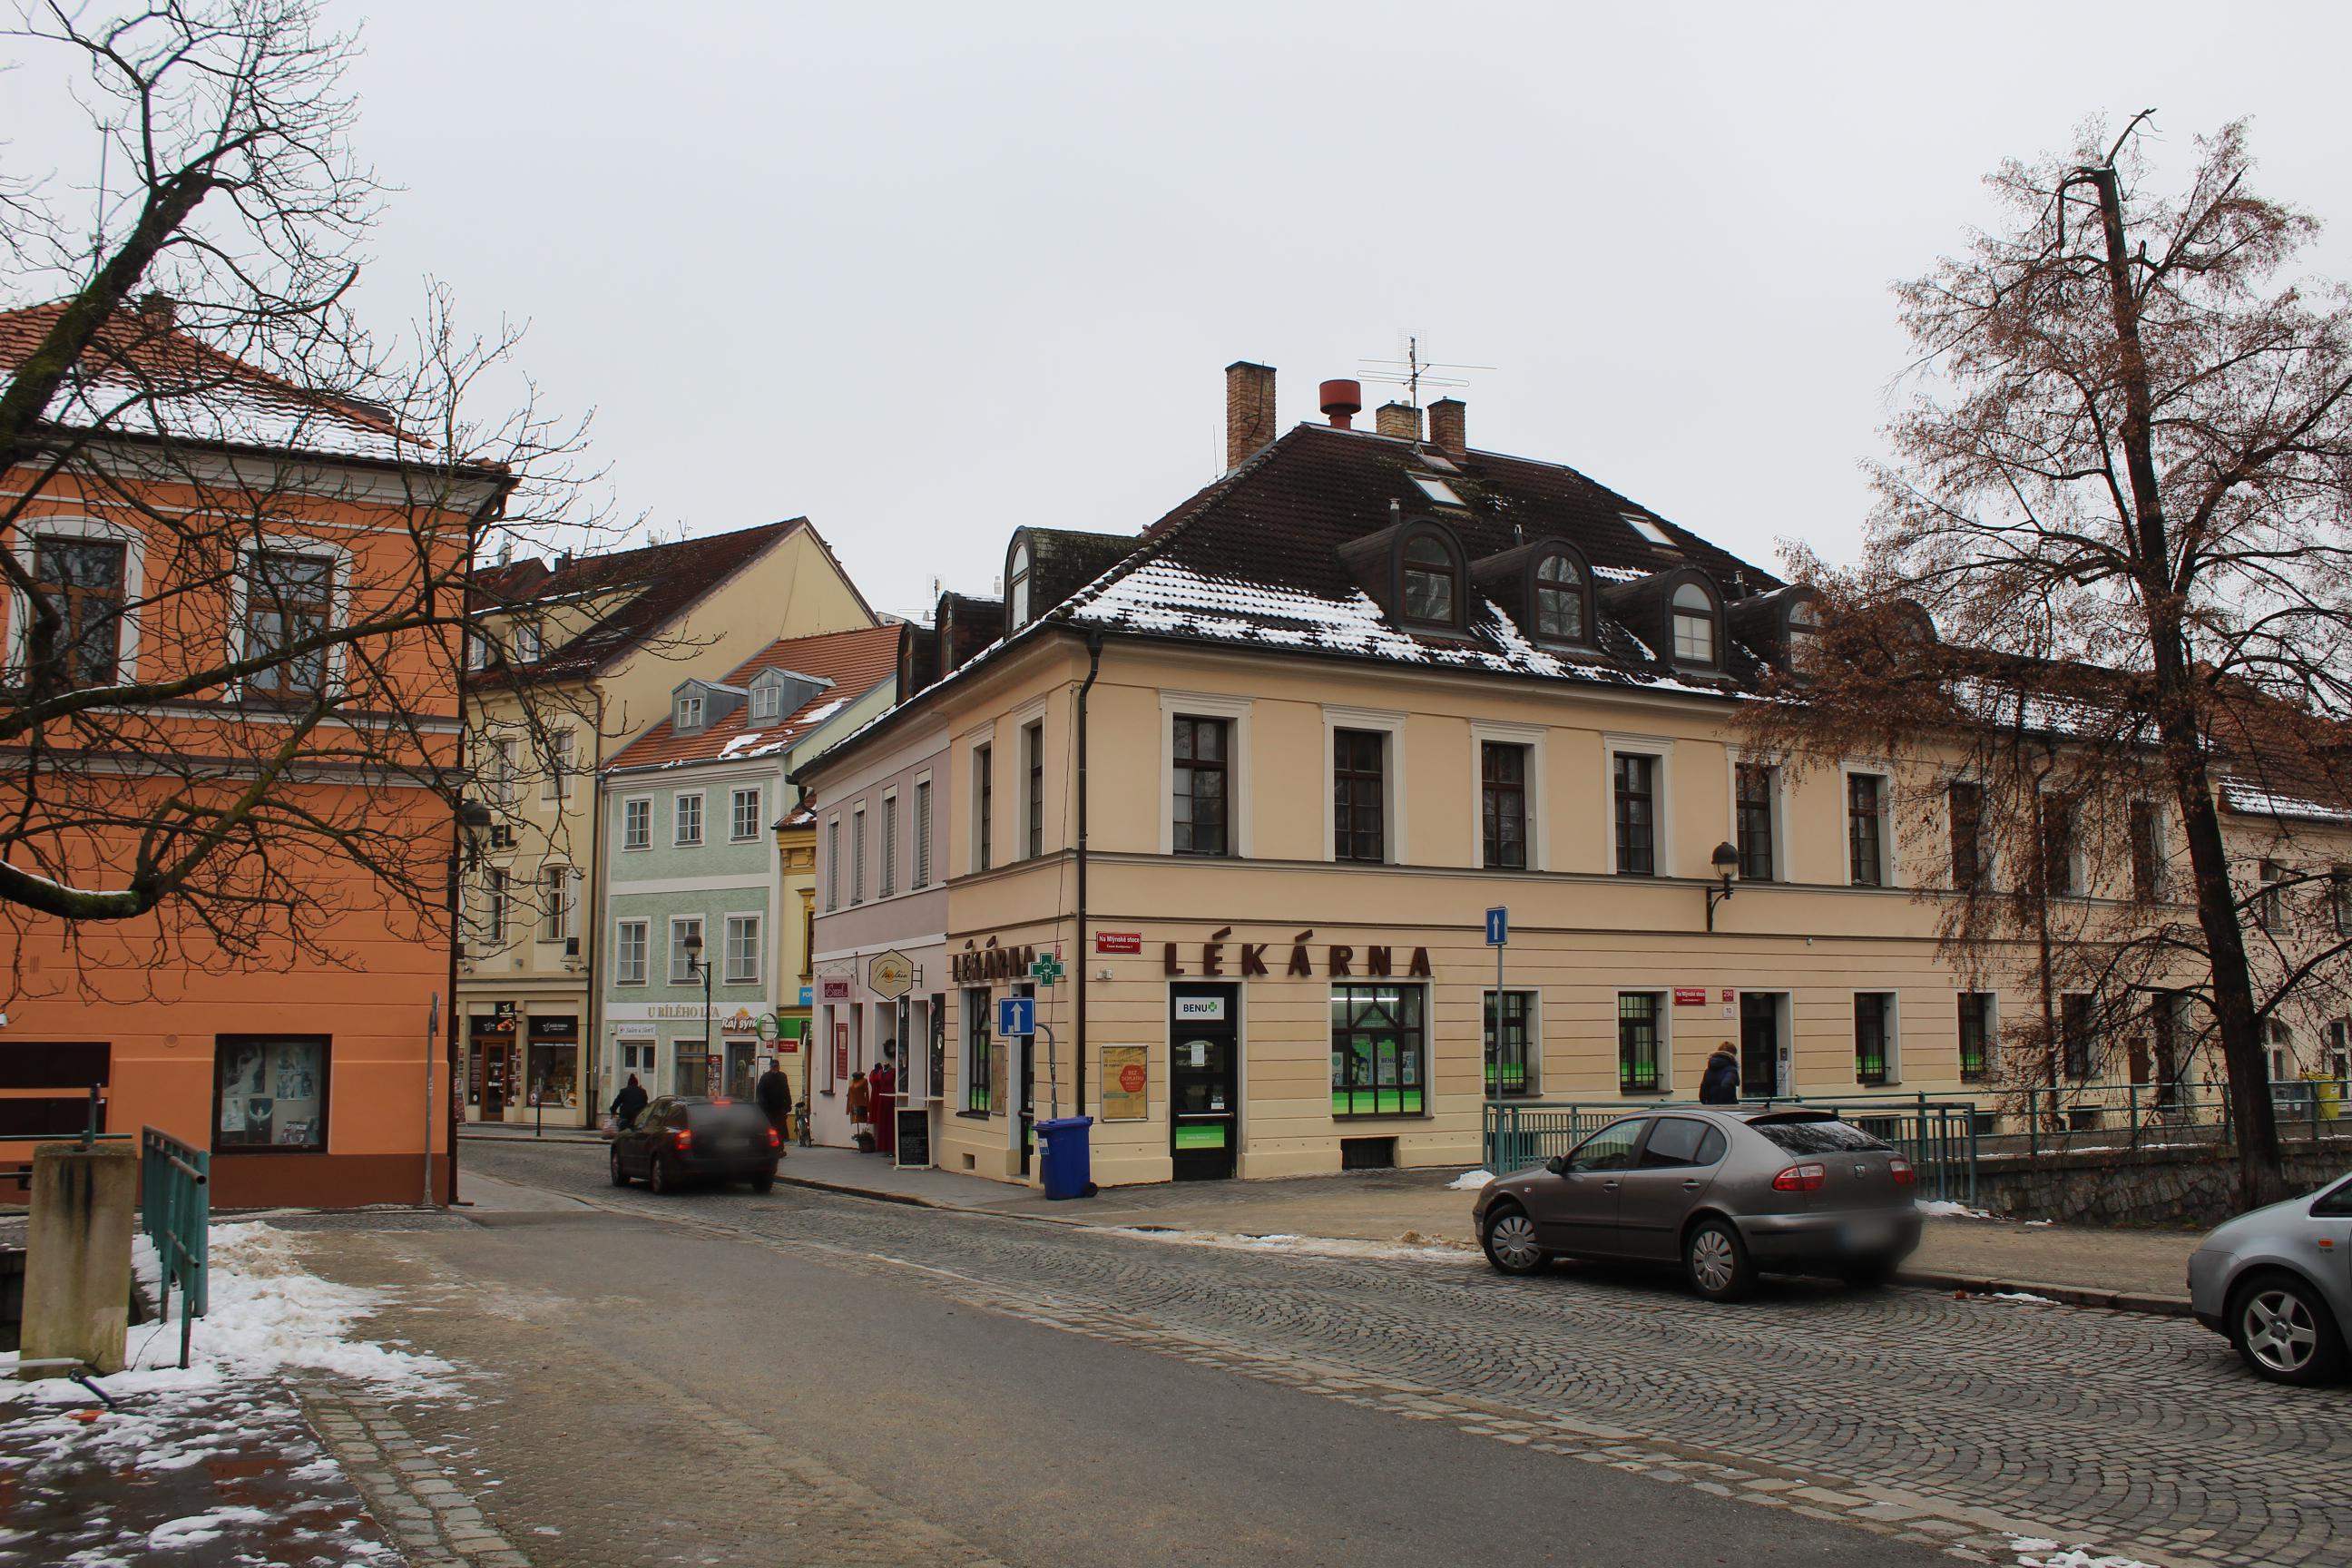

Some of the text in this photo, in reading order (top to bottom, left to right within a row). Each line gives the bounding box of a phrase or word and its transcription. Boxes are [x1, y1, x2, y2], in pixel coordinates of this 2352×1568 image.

[1107, 936, 1126, 944] Mlýnské
[1165, 926, 1431, 976] LÉKÁRNA
[953, 936, 1033, 982] LÉKÁRNA
[648, 1007, 655, 1017] U
[658, 1004, 698, 1017] BÍLÉHO
[1183, 1004, 1208, 1013] BENU
[721, 1016, 737, 1029] Ráj
